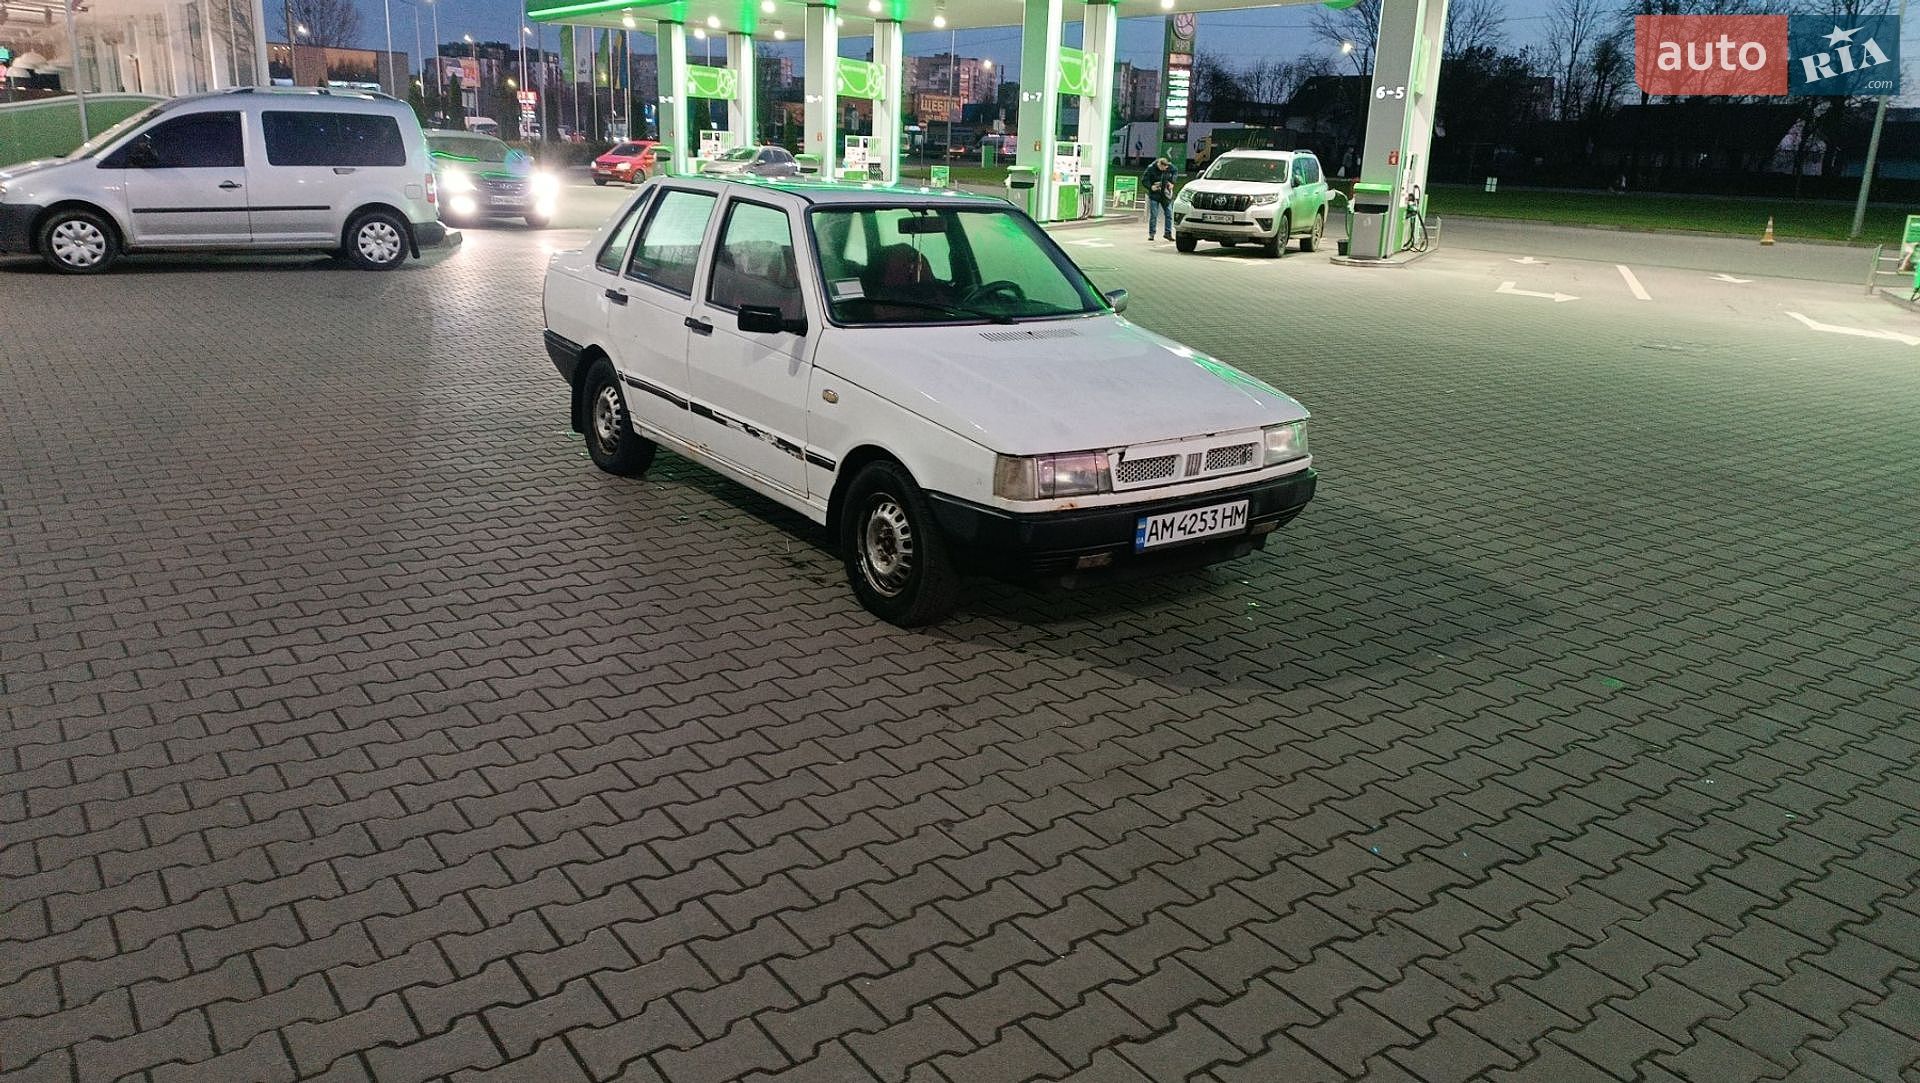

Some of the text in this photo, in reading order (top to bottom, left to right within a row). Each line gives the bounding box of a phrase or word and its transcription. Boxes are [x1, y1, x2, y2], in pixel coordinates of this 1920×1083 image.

[1147, 504, 1247, 543] AM 4253 HM
